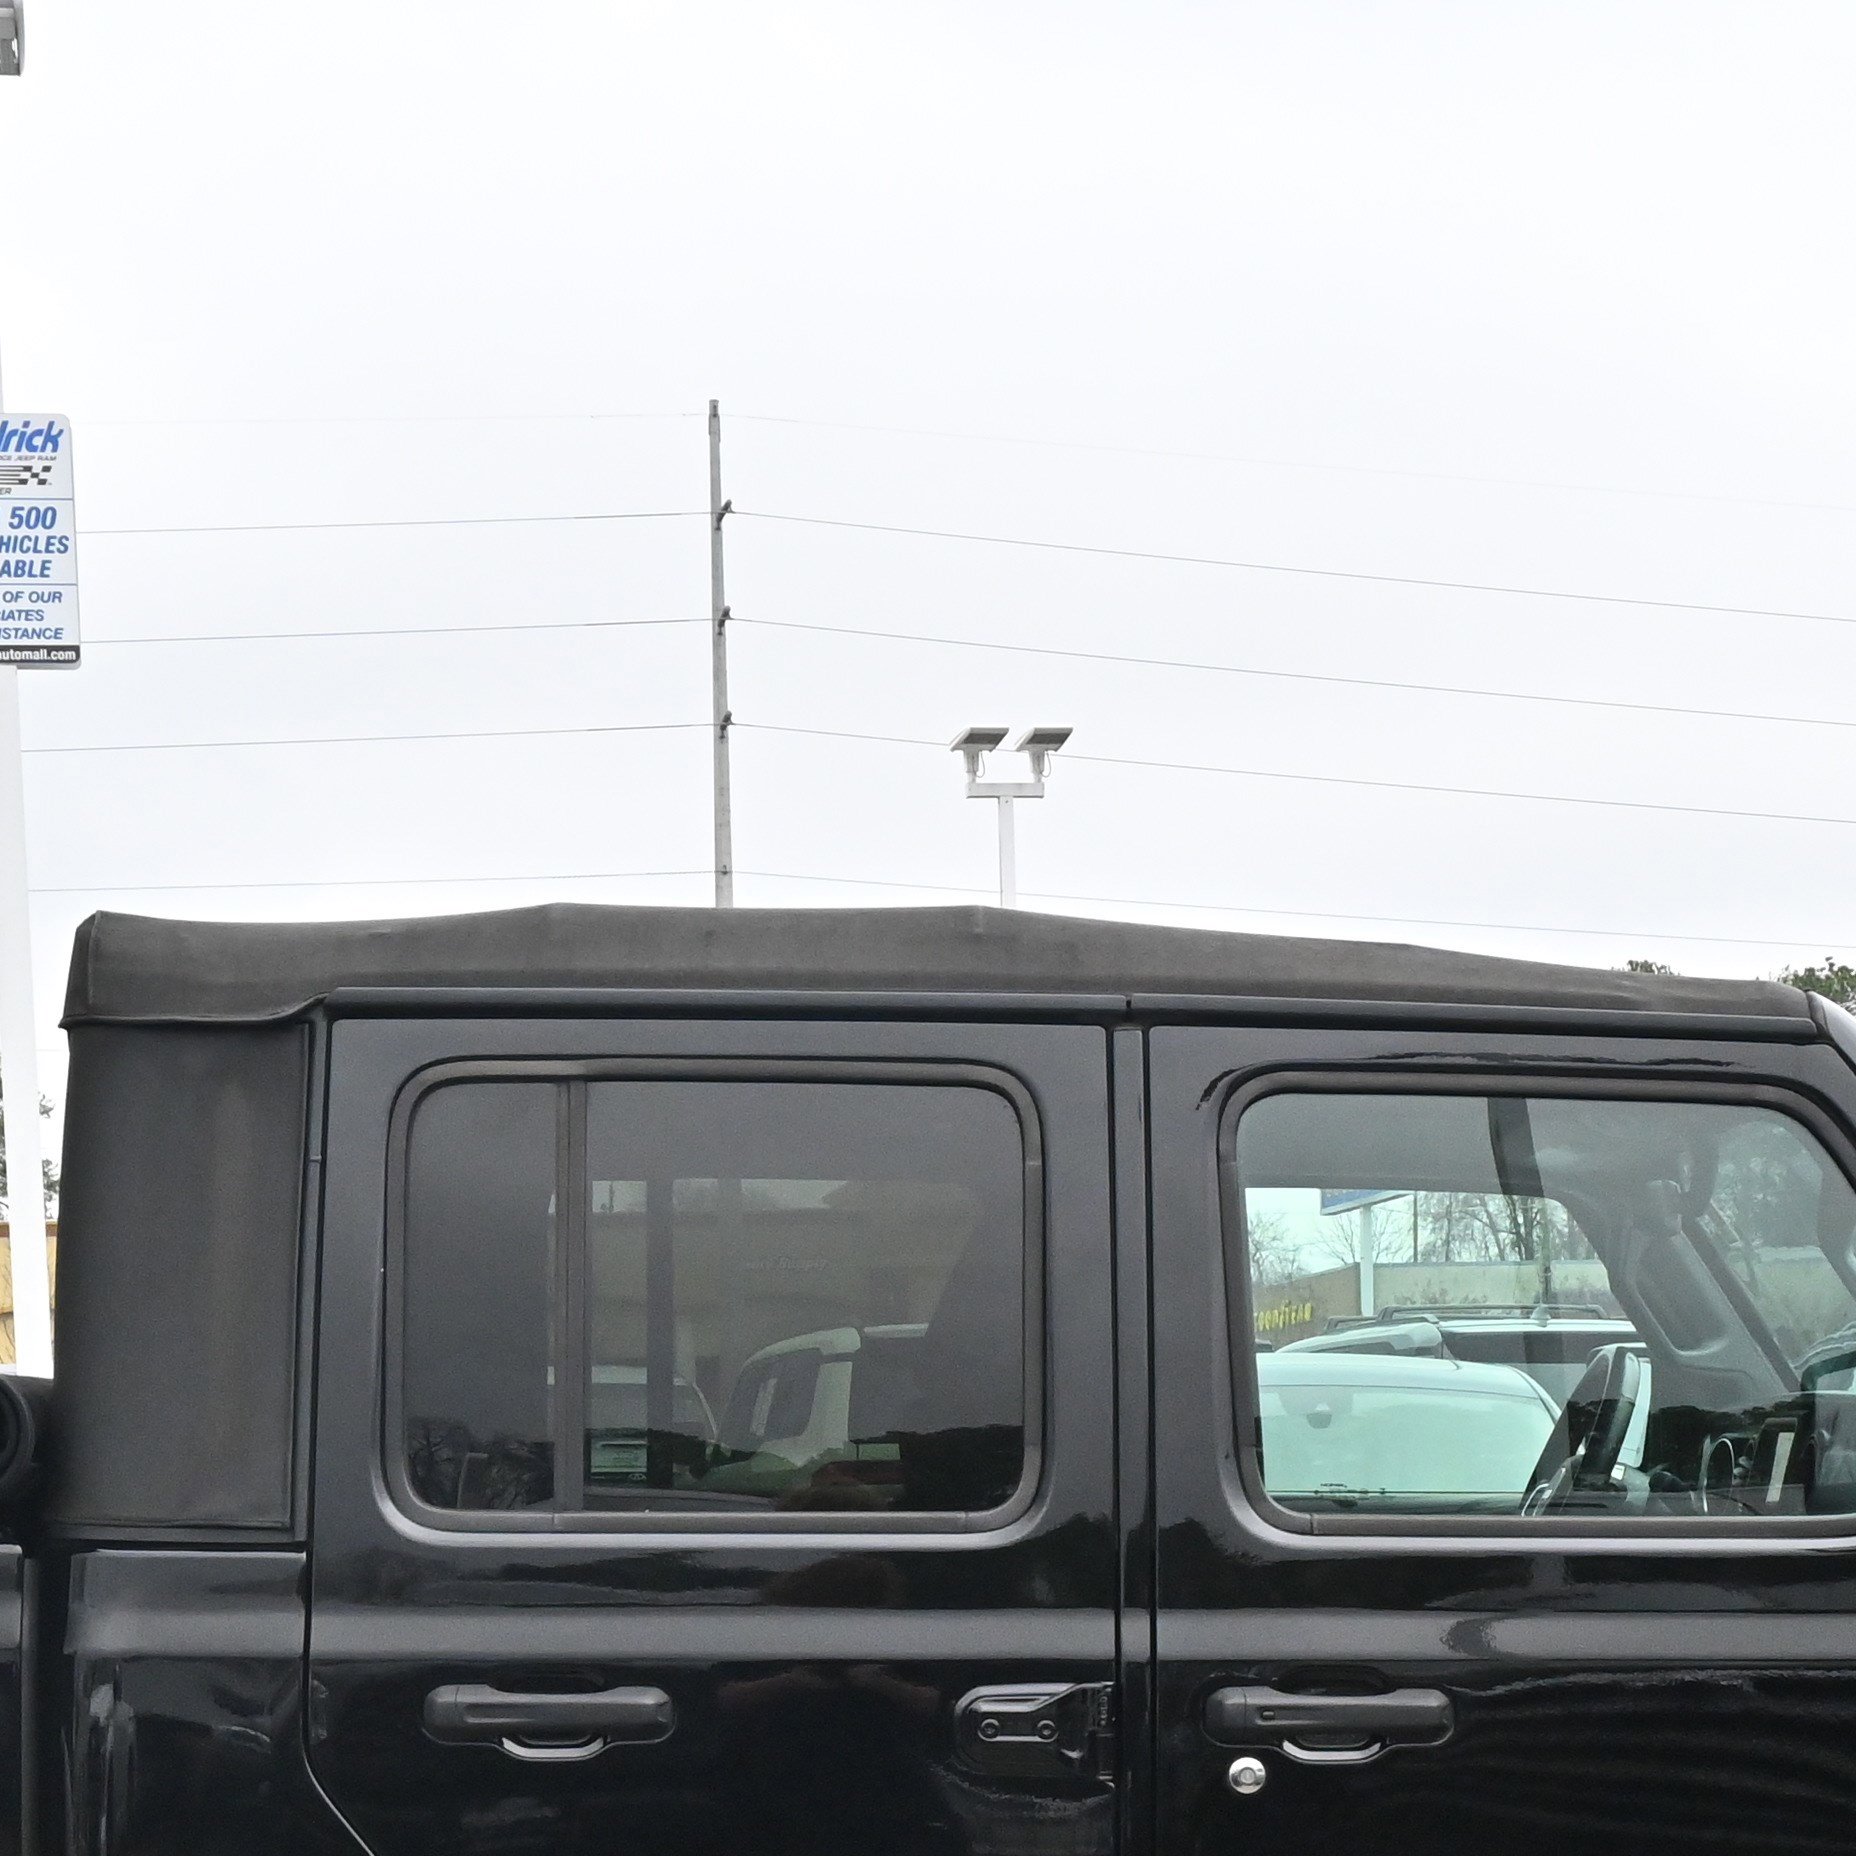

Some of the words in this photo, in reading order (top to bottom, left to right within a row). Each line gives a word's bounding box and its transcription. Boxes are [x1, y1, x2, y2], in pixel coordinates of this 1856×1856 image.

[15, 454, 36, 462] JEEP
[8, 505, 57, 531] 500
[2, 590, 25, 604] OF
[28, 590, 63, 604] OUR
